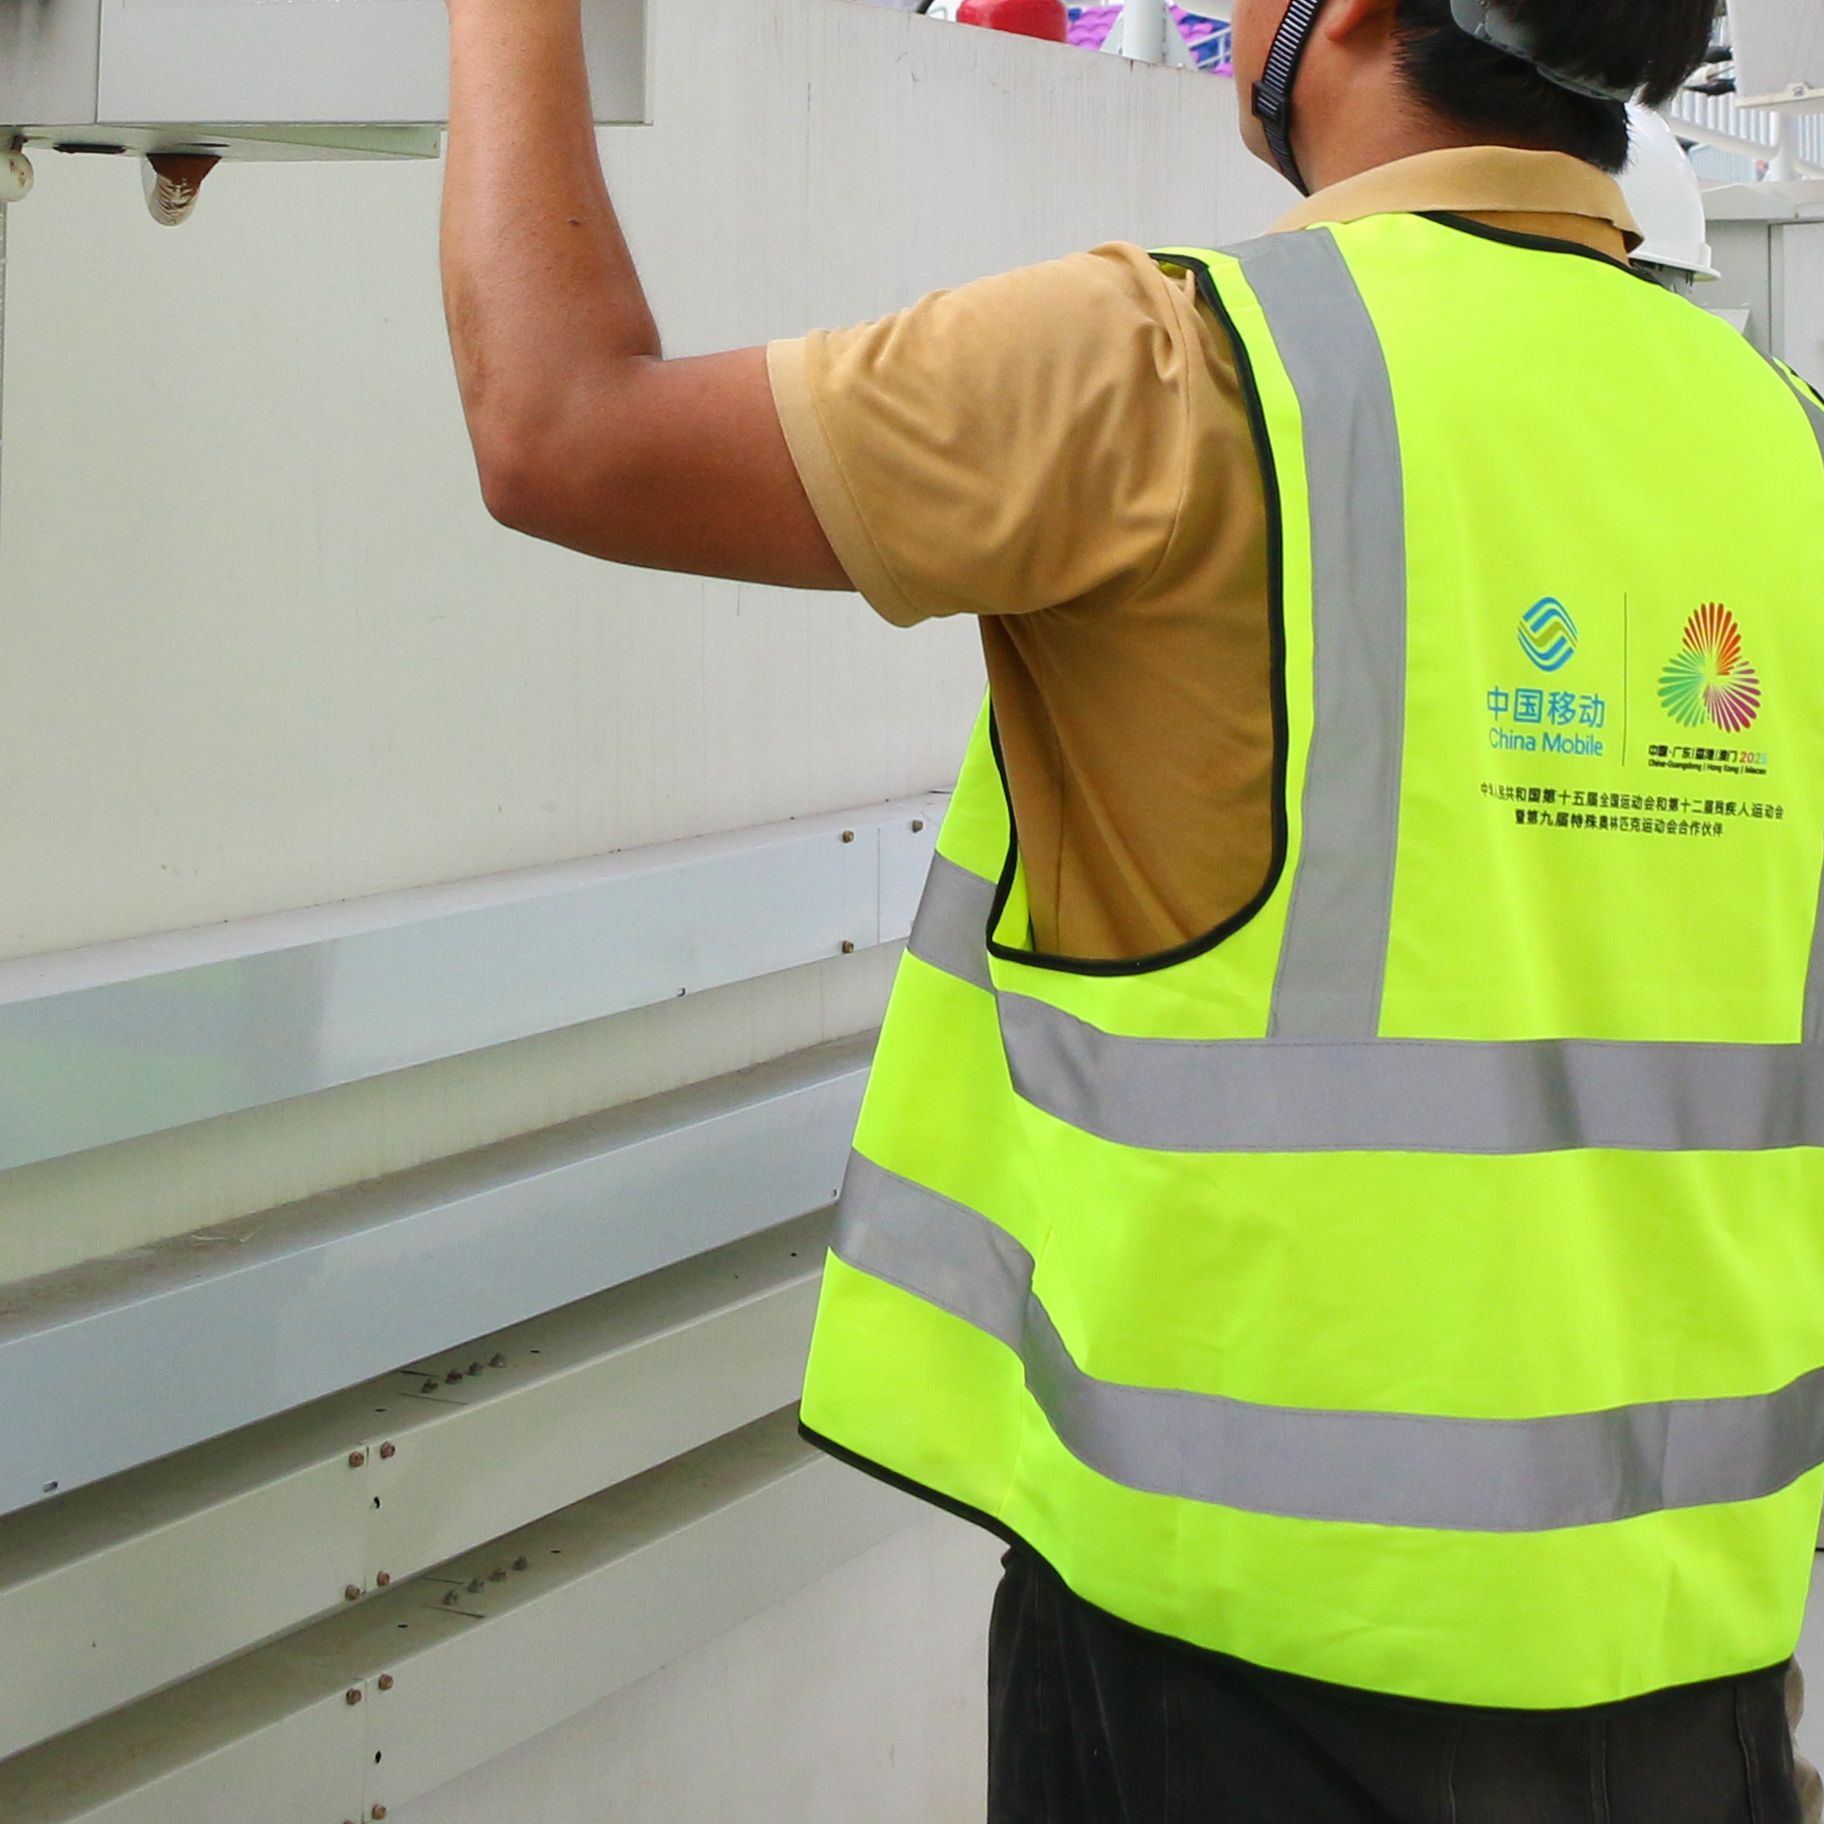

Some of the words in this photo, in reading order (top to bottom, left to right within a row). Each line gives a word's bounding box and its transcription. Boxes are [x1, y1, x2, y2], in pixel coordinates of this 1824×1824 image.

[1487, 685, 1605, 728] 中国移动
[1489, 727, 1536, 751] China
[1542, 732, 1603, 756] Mobile
